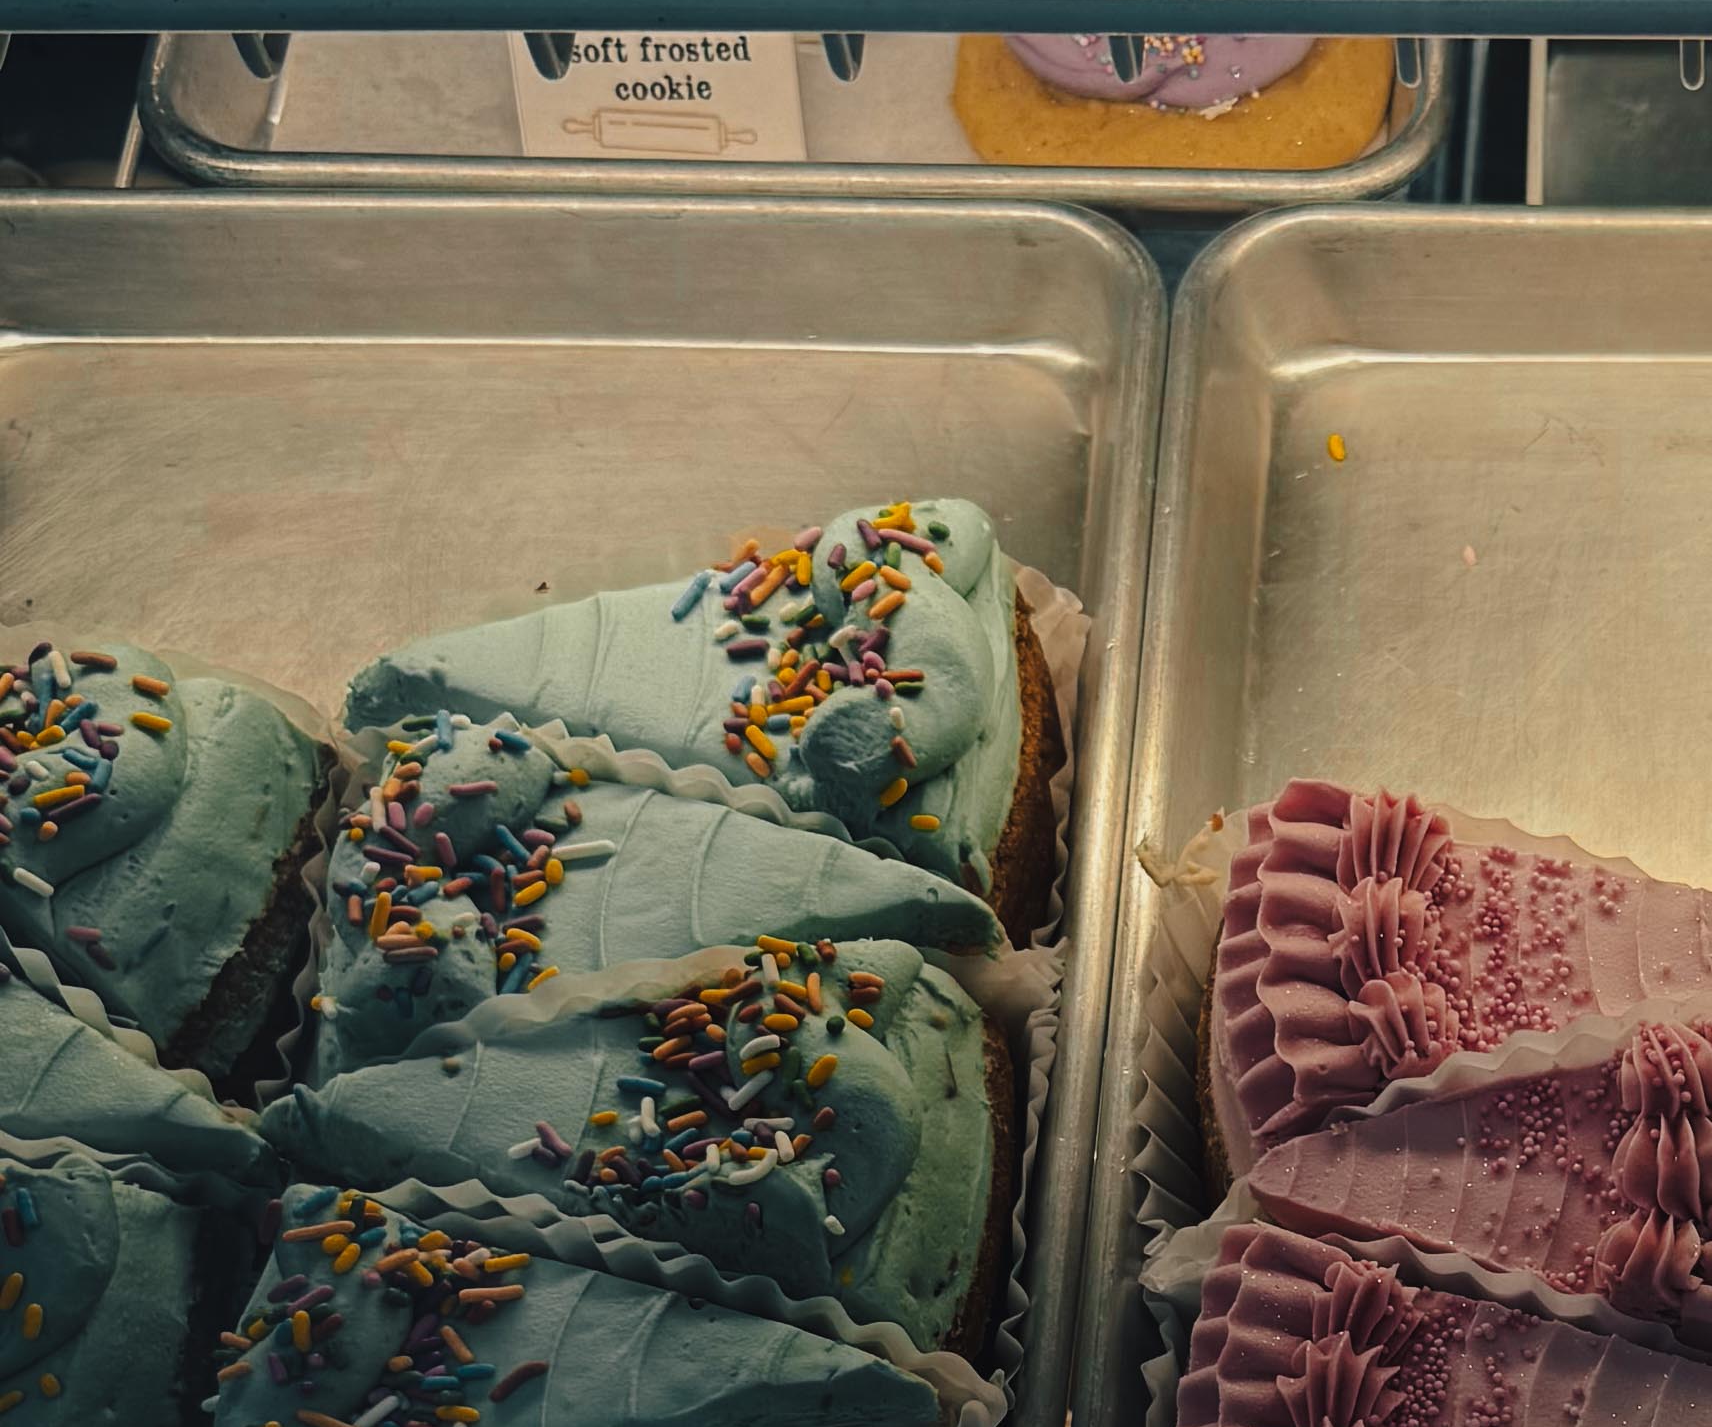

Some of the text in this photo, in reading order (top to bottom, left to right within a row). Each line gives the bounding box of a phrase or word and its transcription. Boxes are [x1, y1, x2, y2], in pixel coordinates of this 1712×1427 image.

[572, 36, 752, 63] soft frosted
[615, 75, 713, 102] cookie
